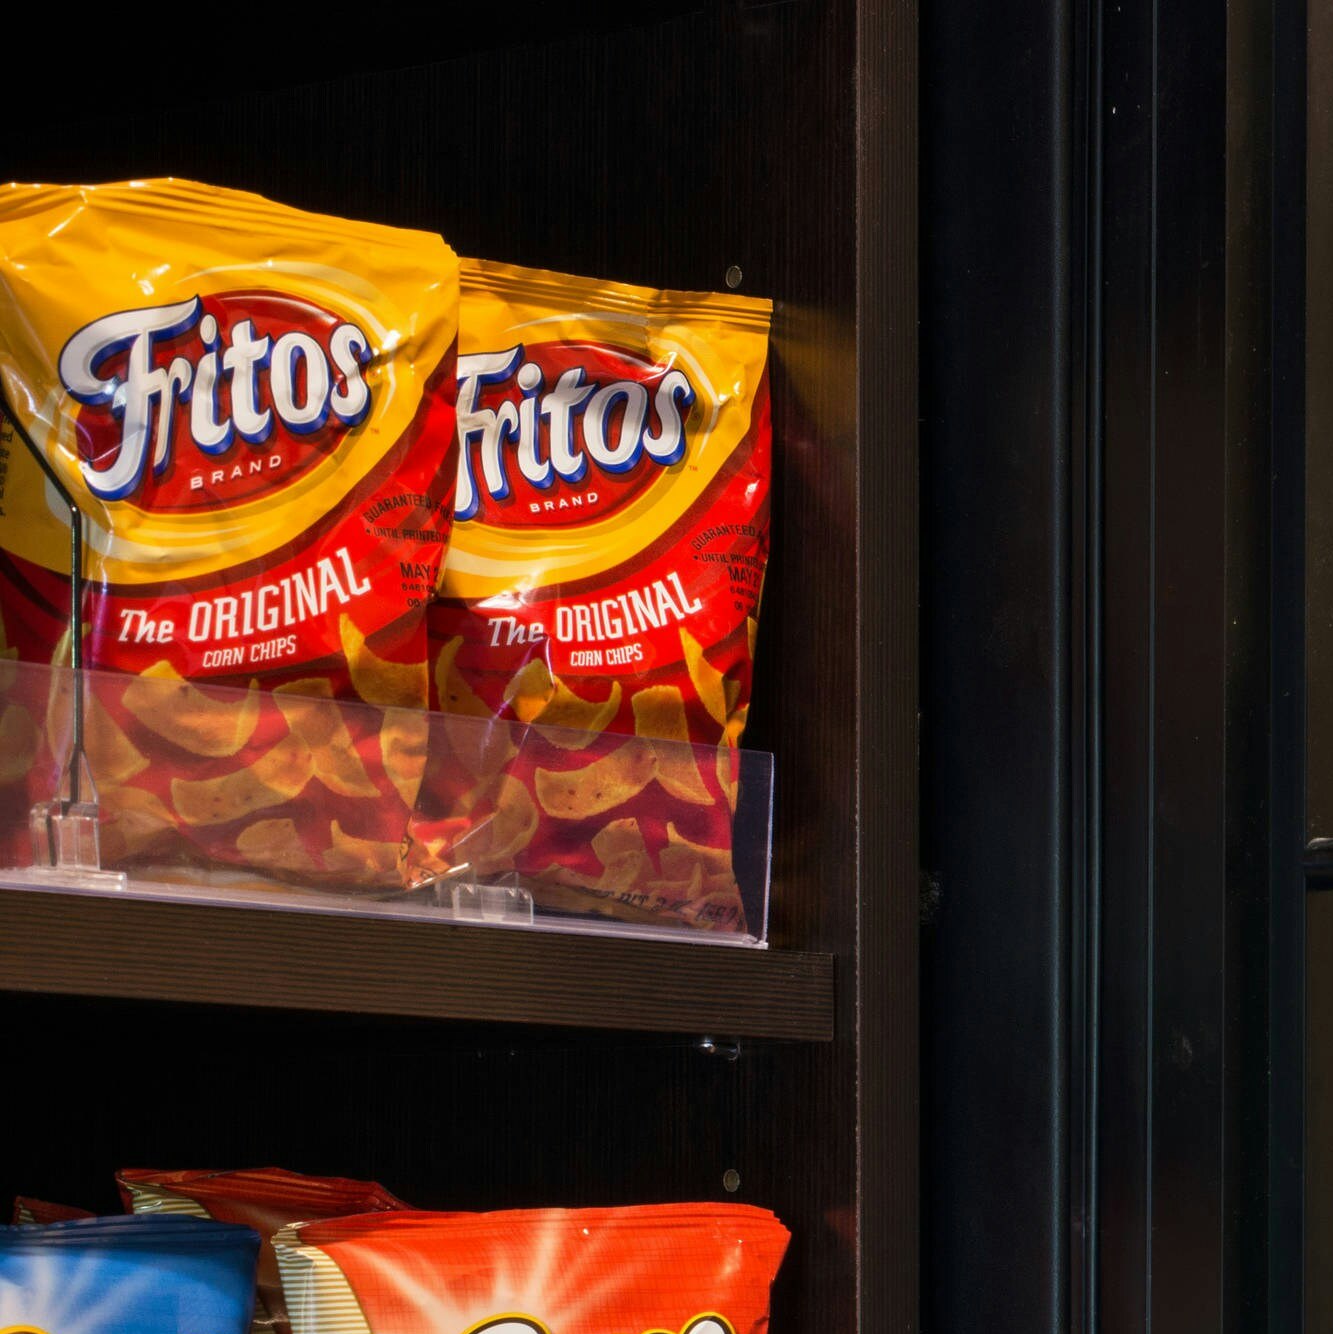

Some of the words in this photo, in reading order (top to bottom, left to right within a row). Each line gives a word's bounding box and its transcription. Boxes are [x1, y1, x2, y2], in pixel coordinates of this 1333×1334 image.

[58, 294, 372, 501] Fritos
[454, 343, 697, 522] Fritos
[189, 453, 283, 491] BRAND
[529, 492, 599, 513] BRAND
[691, 524, 757, 551] GUARANTEED
[399, 561, 431, 579] MAY
[728, 565, 752, 585] MAY
[117, 608, 175, 644] The
[187, 546, 372, 643] ORIGINAL
[487, 616, 547, 648] The
[555, 571, 703, 643] ORIGINAL
[202, 646, 245, 669] CORN
[250, 634, 297, 663] CHIPS
[569, 650, 603, 667] CORN
[606, 643, 644, 666] CHIPS
